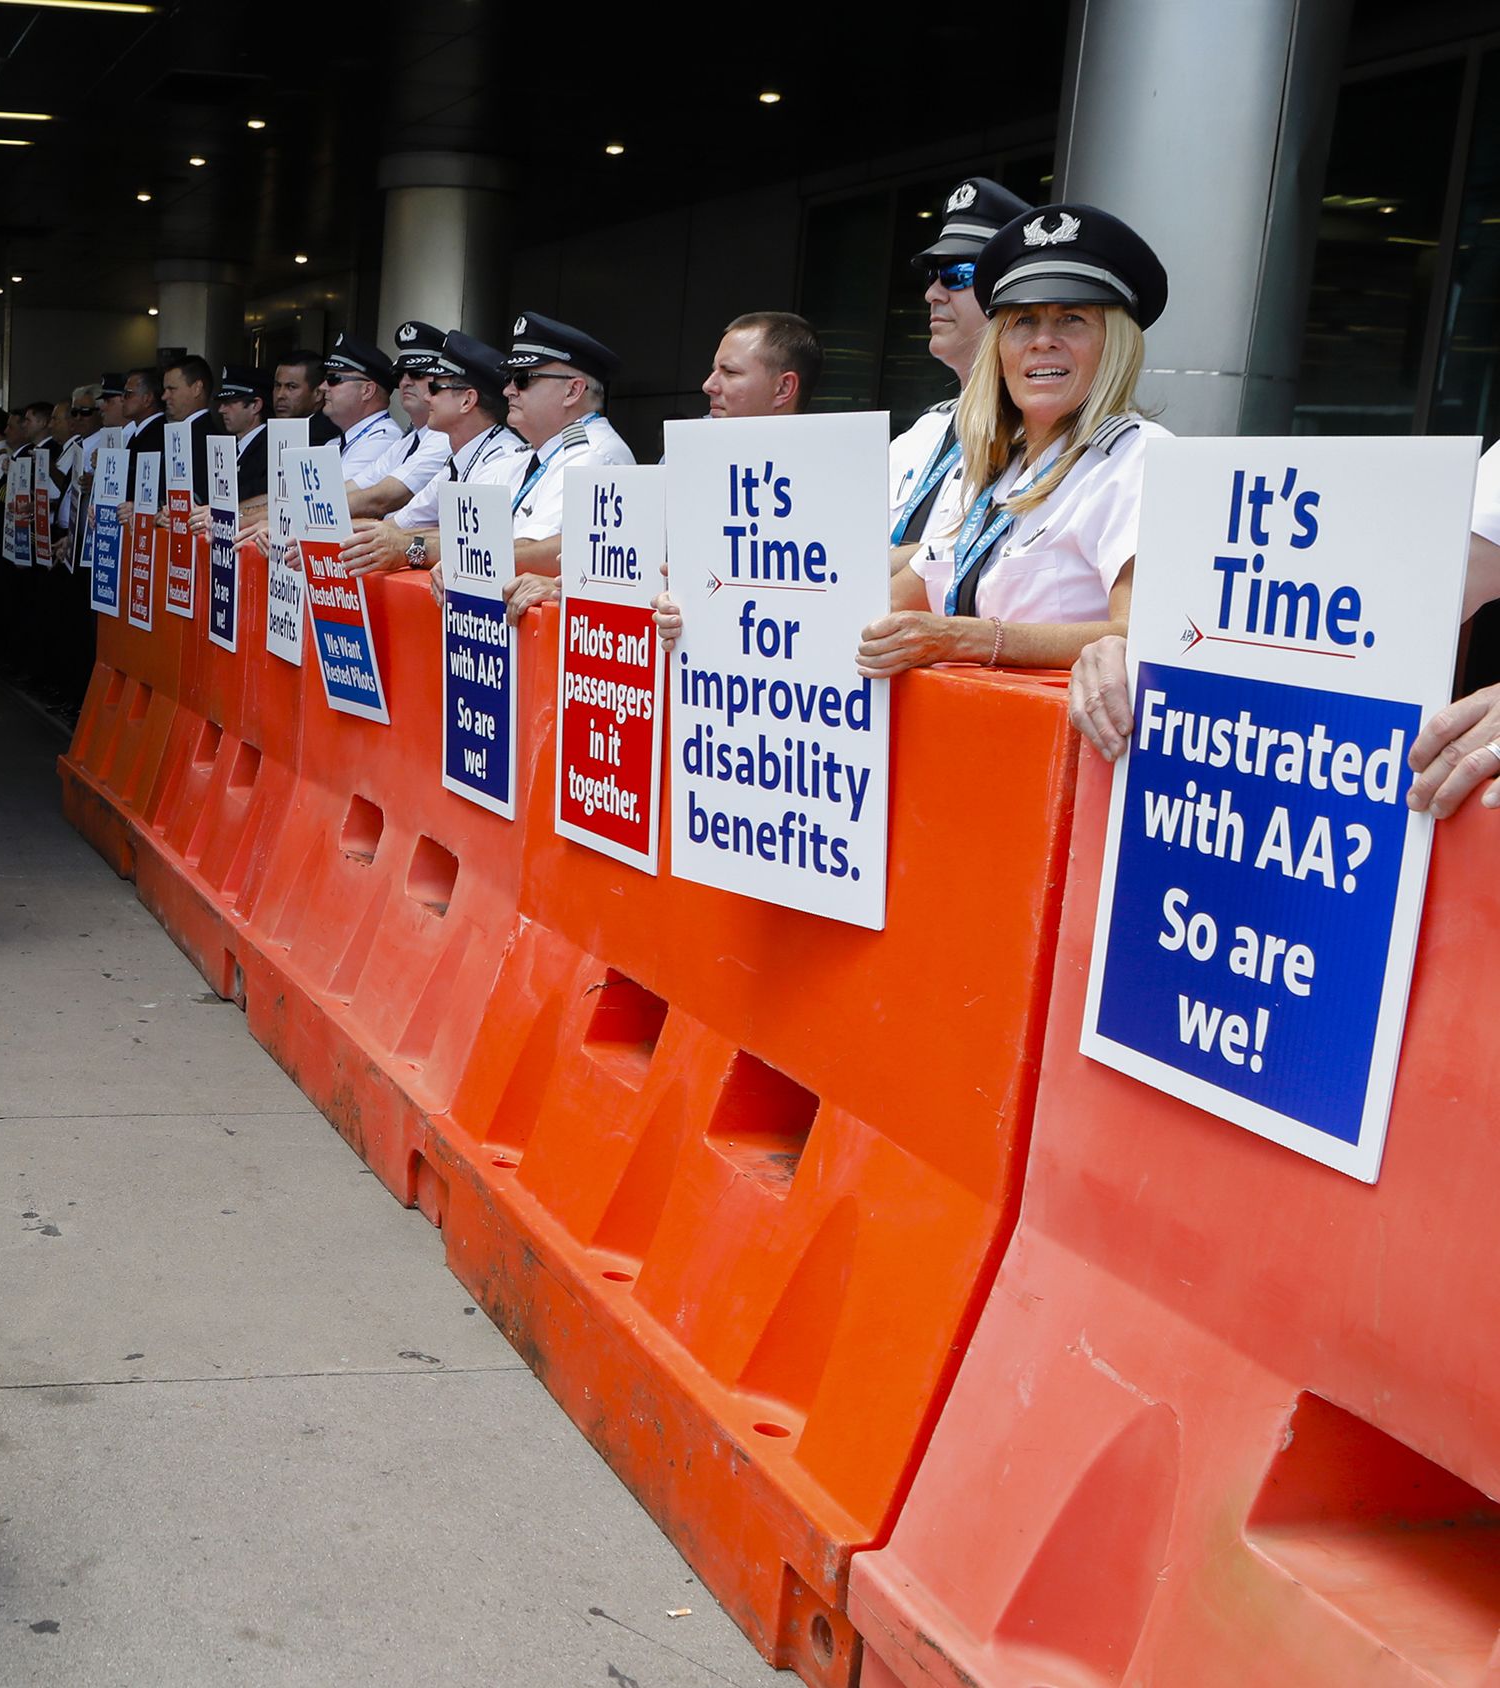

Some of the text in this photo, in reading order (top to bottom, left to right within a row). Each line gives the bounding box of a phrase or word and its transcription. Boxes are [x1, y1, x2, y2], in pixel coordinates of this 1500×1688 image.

[172, 430, 181, 453] It's
[214, 444, 224, 471] It's
[105, 456, 116, 475] It's
[142, 459, 150, 480] It's
[172, 456, 186, 478] Time.
[214, 471, 230, 497] Time.
[300, 459, 320, 490] It's
[104, 477, 120, 496] Time.
[141, 482, 152, 503] Time.
[593, 482, 623, 529] It's
[729, 460, 792, 518] It's
[279, 508, 291, 536] for
[304, 495, 338, 526] Time.
[457, 496, 479, 535] It's
[989, 511, 1012, 537] Time.
[1226, 467, 1321, 549] It's
[212, 543, 222, 568] with
[309, 555, 349, 579] You Want
[457, 536, 497, 578] Time.
[589, 532, 642, 581] Time.
[723, 524, 839, 584] Time.
[214, 577, 229, 603] So are
[269, 574, 301, 614] disability
[309, 584, 360, 611] Rested Pilots
[1212, 553, 1376, 649] Time.
[216, 609, 226, 630] we!
[268, 605, 297, 642] benefits.
[446, 602, 508, 648] Frustrated
[738, 600, 800, 660] for
[324, 632, 363, 661] We Want
[570, 613, 649, 668] Pilots and
[325, 661, 376, 692] Rested Pilots
[450, 648, 504, 691] with AA?
[565, 670, 653, 724] passengers
[680, 652, 871, 732] improved
[457, 698, 496, 741] So are
[464, 745, 487, 780] we!
[590, 723, 621, 767] in it
[1139, 689, 1405, 805] Frustrated
[682, 723, 871, 823] disability
[569, 769, 641, 824] together.
[687, 790, 861, 882] benefits.
[1143, 781, 1373, 895] with AA?
[1158, 887, 1315, 998] So are
[1178, 994, 1270, 1074] we!
